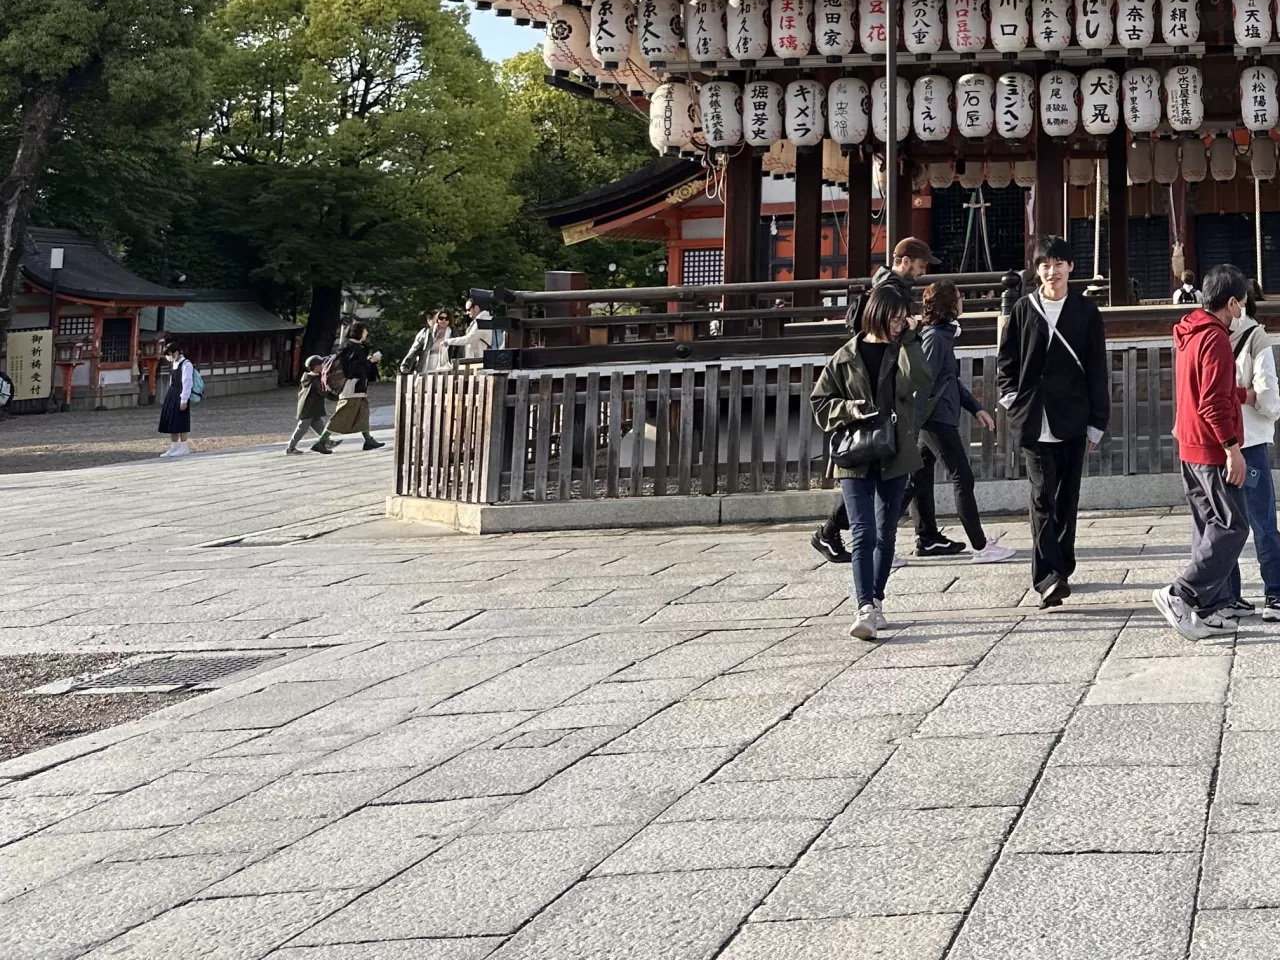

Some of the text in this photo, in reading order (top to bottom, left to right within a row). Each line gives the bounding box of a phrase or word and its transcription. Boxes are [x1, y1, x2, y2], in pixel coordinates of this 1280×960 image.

[1083, 0, 1100, 39] にし
[1245, 10, 1261, 38] 天塩
[1050, 76, 1063, 99] 北尾
[1090, 77, 1110, 124] 大晃
[1252, 70, 1267, 124] 小松陽一郎
[751, 85, 768, 139] 堀田芳史
[793, 85, 811, 137] キメラ
[921, 105, 936, 133] えん
[963, 91, 982, 127] 石屋
